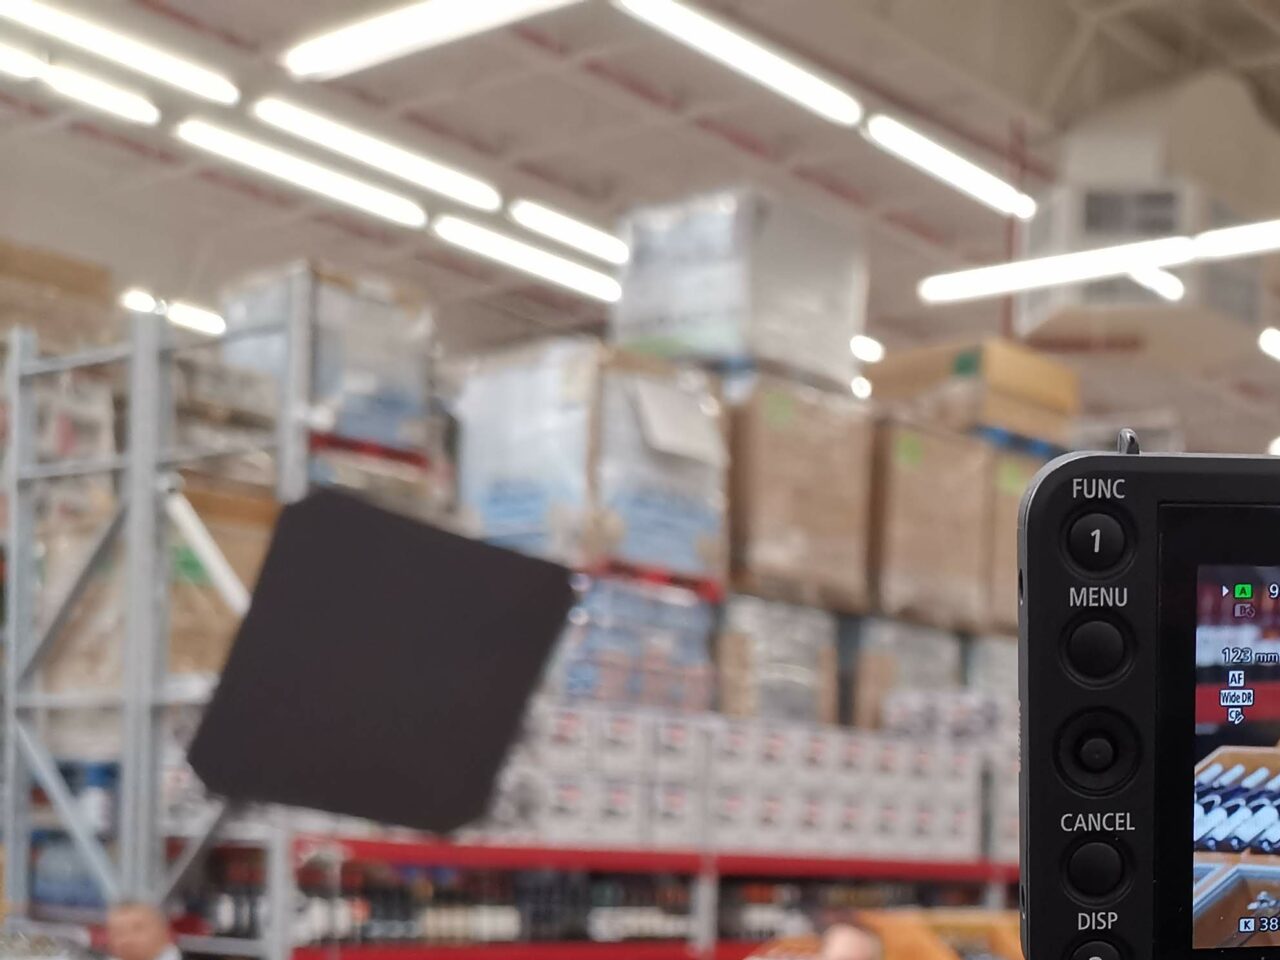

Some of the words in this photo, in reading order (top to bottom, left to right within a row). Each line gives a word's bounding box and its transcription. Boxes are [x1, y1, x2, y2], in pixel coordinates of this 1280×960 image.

[1072, 479, 1125, 499] FUNC
[1090, 529, 1102, 553] 1
[1069, 587, 1128, 608] MENU
[1221, 647, 1253, 664] 123
[1255, 652, 1280, 663] mm
[1229, 672, 1243, 685] AF
[1221, 691, 1241, 704] Wide
[1242, 691, 1253, 704] DR
[1060, 812, 1135, 832] CANCEL
[1077, 911, 1119, 931] DISP
[1243, 920, 1251, 931] K
